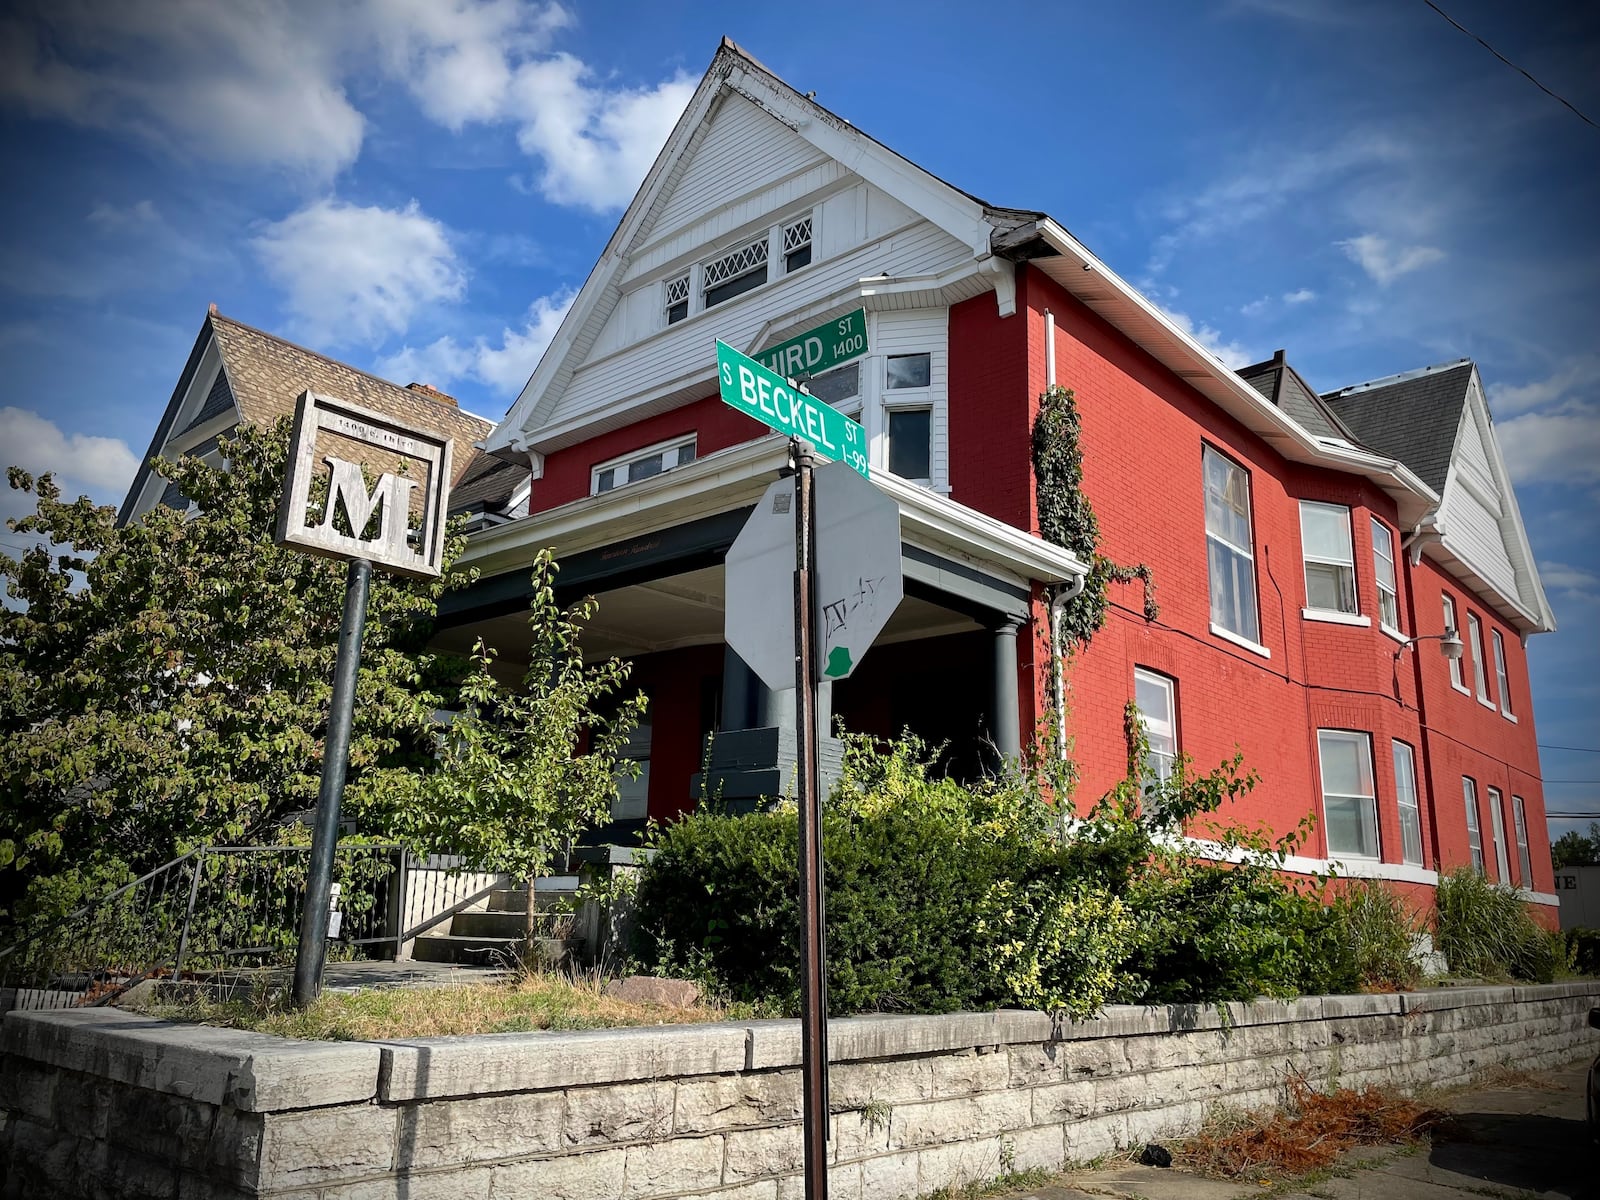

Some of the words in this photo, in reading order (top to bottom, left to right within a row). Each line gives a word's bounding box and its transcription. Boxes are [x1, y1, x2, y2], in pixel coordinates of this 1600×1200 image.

[838, 317, 853, 336] ST
[760, 336, 824, 378] HIRD
[833, 334, 863, 359] 1400
[722, 362, 733, 386] S
[739, 364, 836, 451] BECKEL
[844, 421, 858, 445] ST
[841, 443, 867, 474] 1-99
[304, 456, 425, 560] M
